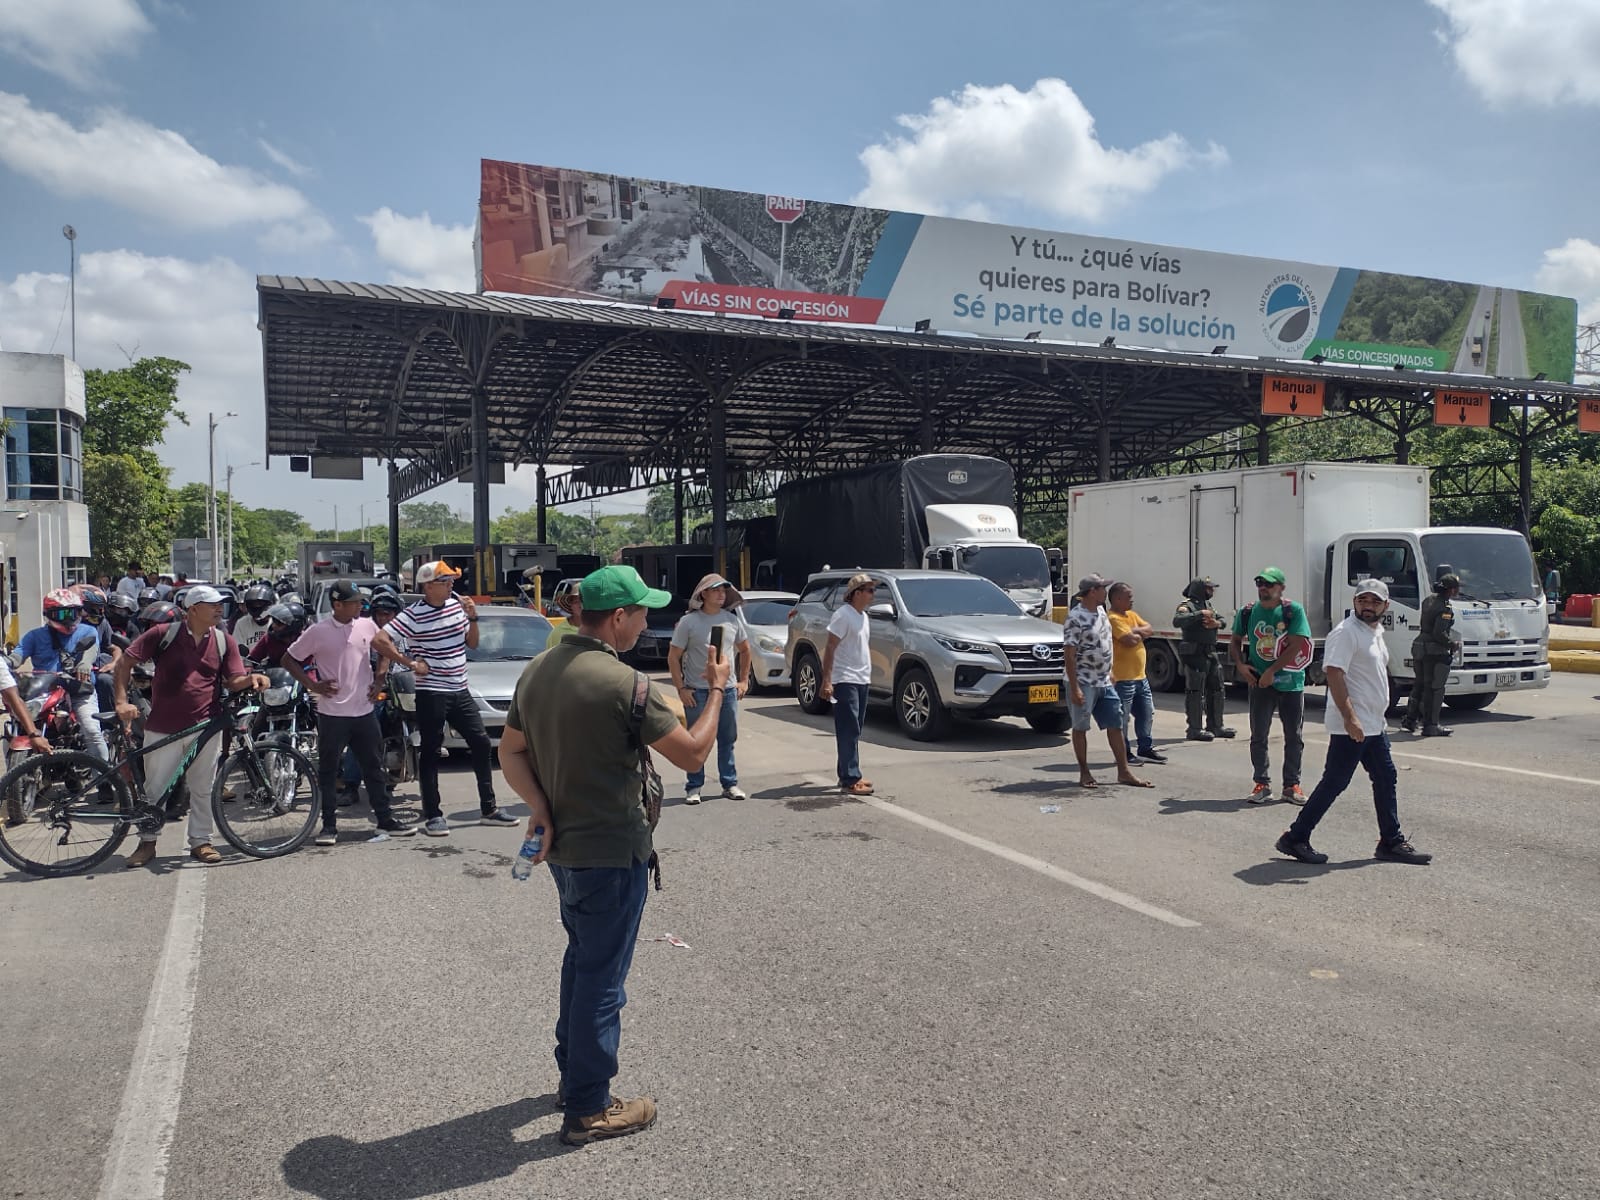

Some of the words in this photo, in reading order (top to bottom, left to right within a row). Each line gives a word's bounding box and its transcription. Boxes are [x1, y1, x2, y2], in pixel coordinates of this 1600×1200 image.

[768, 196, 801, 210] PARE
[1010, 235, 1026, 256] Y
[1032, 238, 1074, 262] tú...
[1080, 248, 1133, 271] ¿qué
[1140, 252, 1181, 274] vías
[978, 267, 1066, 293] quieres
[1072, 279, 1120, 300] para
[1127, 281, 1211, 308] Bolívar?
[1258, 273, 1290, 313] AUTOPISTAS
[1291, 274, 1304, 286] DEL
[681, 289, 721, 307] VÍAS
[724, 294, 752, 310] SIN
[756, 297, 850, 318] CONCESIÓN
[952, 293, 986, 319] Sé
[994, 301, 1064, 326] parte
[1071, 304, 1101, 329] de
[1111, 307, 1130, 332] la
[1138, 312, 1236, 341] solución
[1320, 346, 1345, 359] VÍAS
[1347, 349, 1435, 368] CONCESIONADAS
[1272, 379, 1316, 394] Manual
[1443, 393, 1483, 406] Manual
